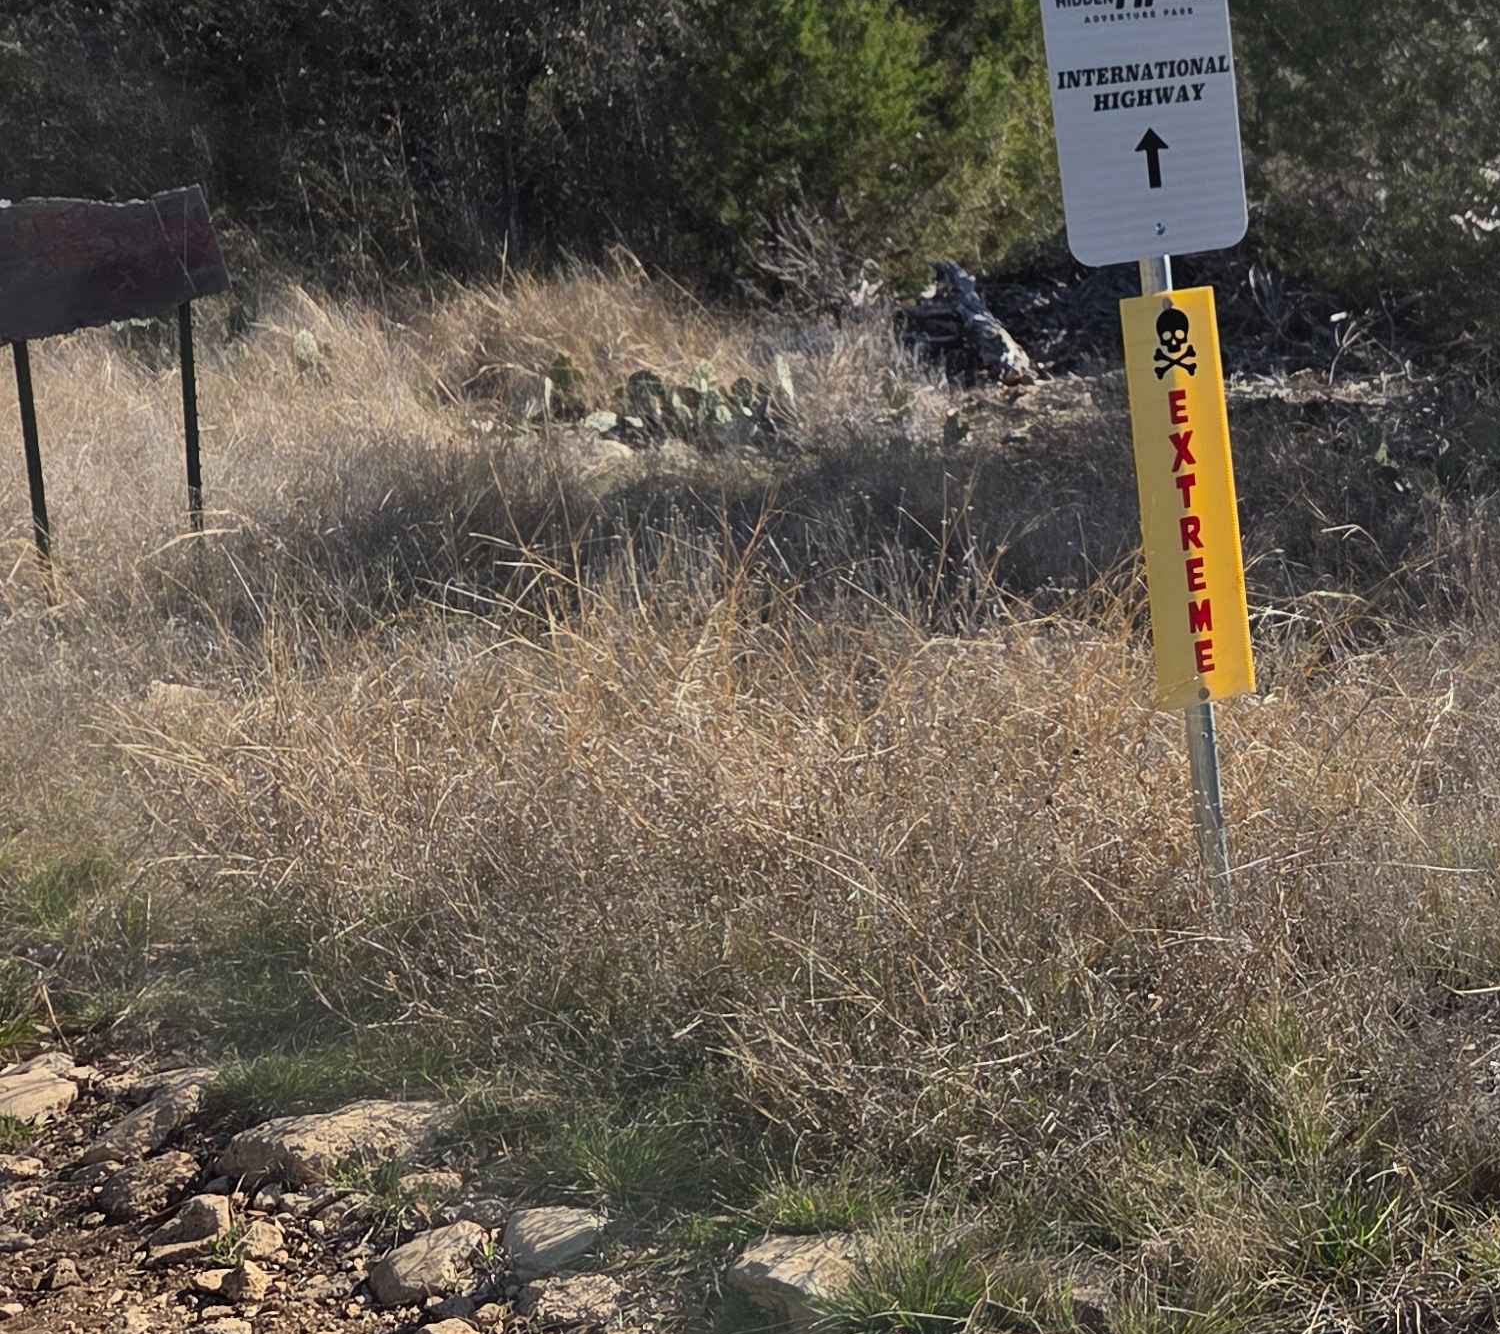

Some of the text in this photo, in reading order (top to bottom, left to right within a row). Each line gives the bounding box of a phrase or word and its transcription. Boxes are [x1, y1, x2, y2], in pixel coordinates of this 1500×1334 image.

[1084, 7, 1194, 24] ADVENTURE PARK
[1057, 55, 1230, 90] INTERNATIONAL
[1093, 83, 1206, 112] HIGHWAY
[1168, 389, 1216, 673] EXTREME
